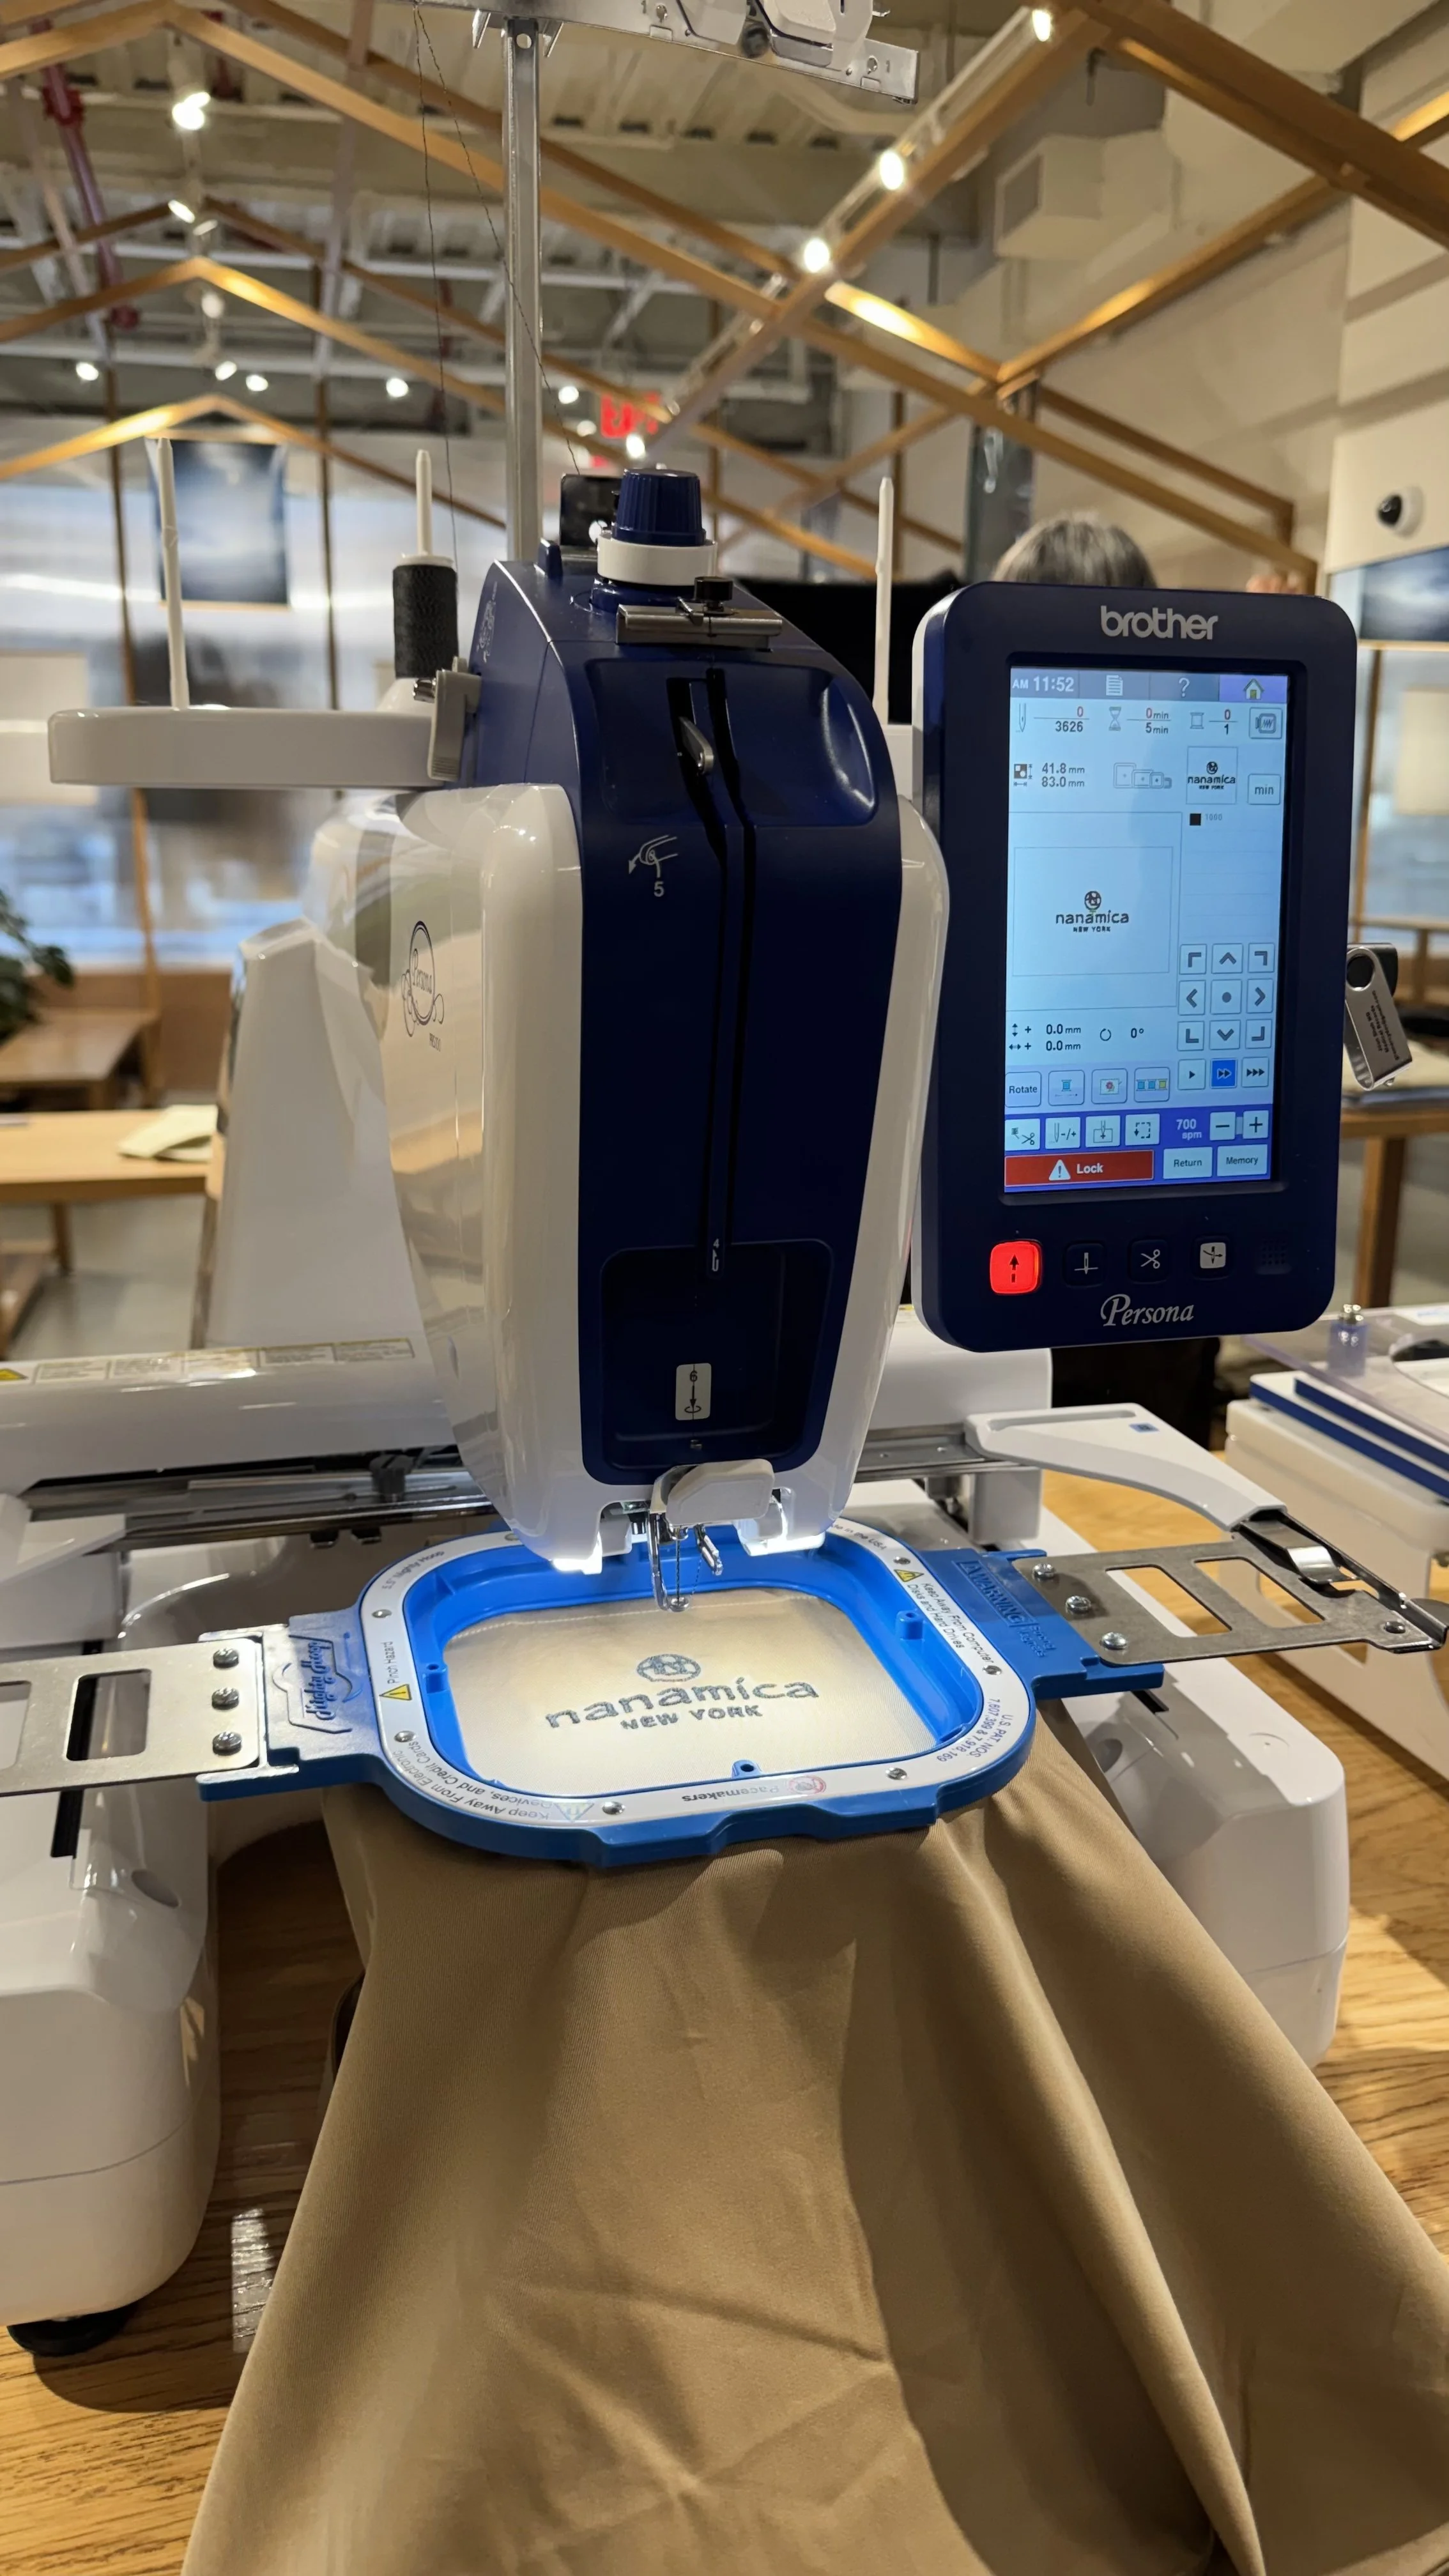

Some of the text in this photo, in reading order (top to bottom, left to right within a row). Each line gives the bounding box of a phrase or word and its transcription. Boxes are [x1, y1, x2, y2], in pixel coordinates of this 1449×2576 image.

[1100, 605, 1219, 640] brother
[1012, 676, 1075, 692] AM 11:52
[1077, 706, 1084, 717] 0
[1224, 709, 1231, 721] 0
[1055, 720, 1084, 733] 3626
[1224, 723, 1229, 735] 1
[1041, 763, 1085, 774] 41.8 mm
[1041, 776, 1085, 788] 83.0 mm
[1187, 774, 1236, 784] nanamica
[1254, 785, 1275, 795] min
[654, 881, 664, 897] 5
[1055, 910, 1130, 925] nanamica
[1046, 1023, 1063, 1035] 0.0
[1046, 1040, 1063, 1051] 0.0
[1009, 1084, 1038, 1094] Rotate
[1176, 1119, 1197, 1130] 700
[1182, 1131, 1202, 1140] spm
[1173, 1158, 1202, 1167] Return
[1226, 1156, 1259, 1165] Memory
[1077, 1162, 1104, 1175] Lock
[1100, 1293, 1195, 1327] Persona
[689, 1370, 698, 1383] 6
[920, 1600, 936, 1612] and
[930, 1613, 949, 1627] Hard
[943, 1629, 965, 1649] Drives
[921, 1583, 995, 1664] Keep Away From Computer
[380, 1641, 401, 1685] Pinch Hazard
[544, 1677, 820, 1729] nanamica
[620, 1704, 763, 1730] NEW YORK
[986, 1729, 1007, 1743] PAT.
[966, 1742, 994, 1758] NOS.
[408, 1740, 555, 1809] Devices, and Credit Cards
[392, 1749, 551, 1821] Keep Away From Electronic
[682, 1784, 779, 1802] Pacemakers
